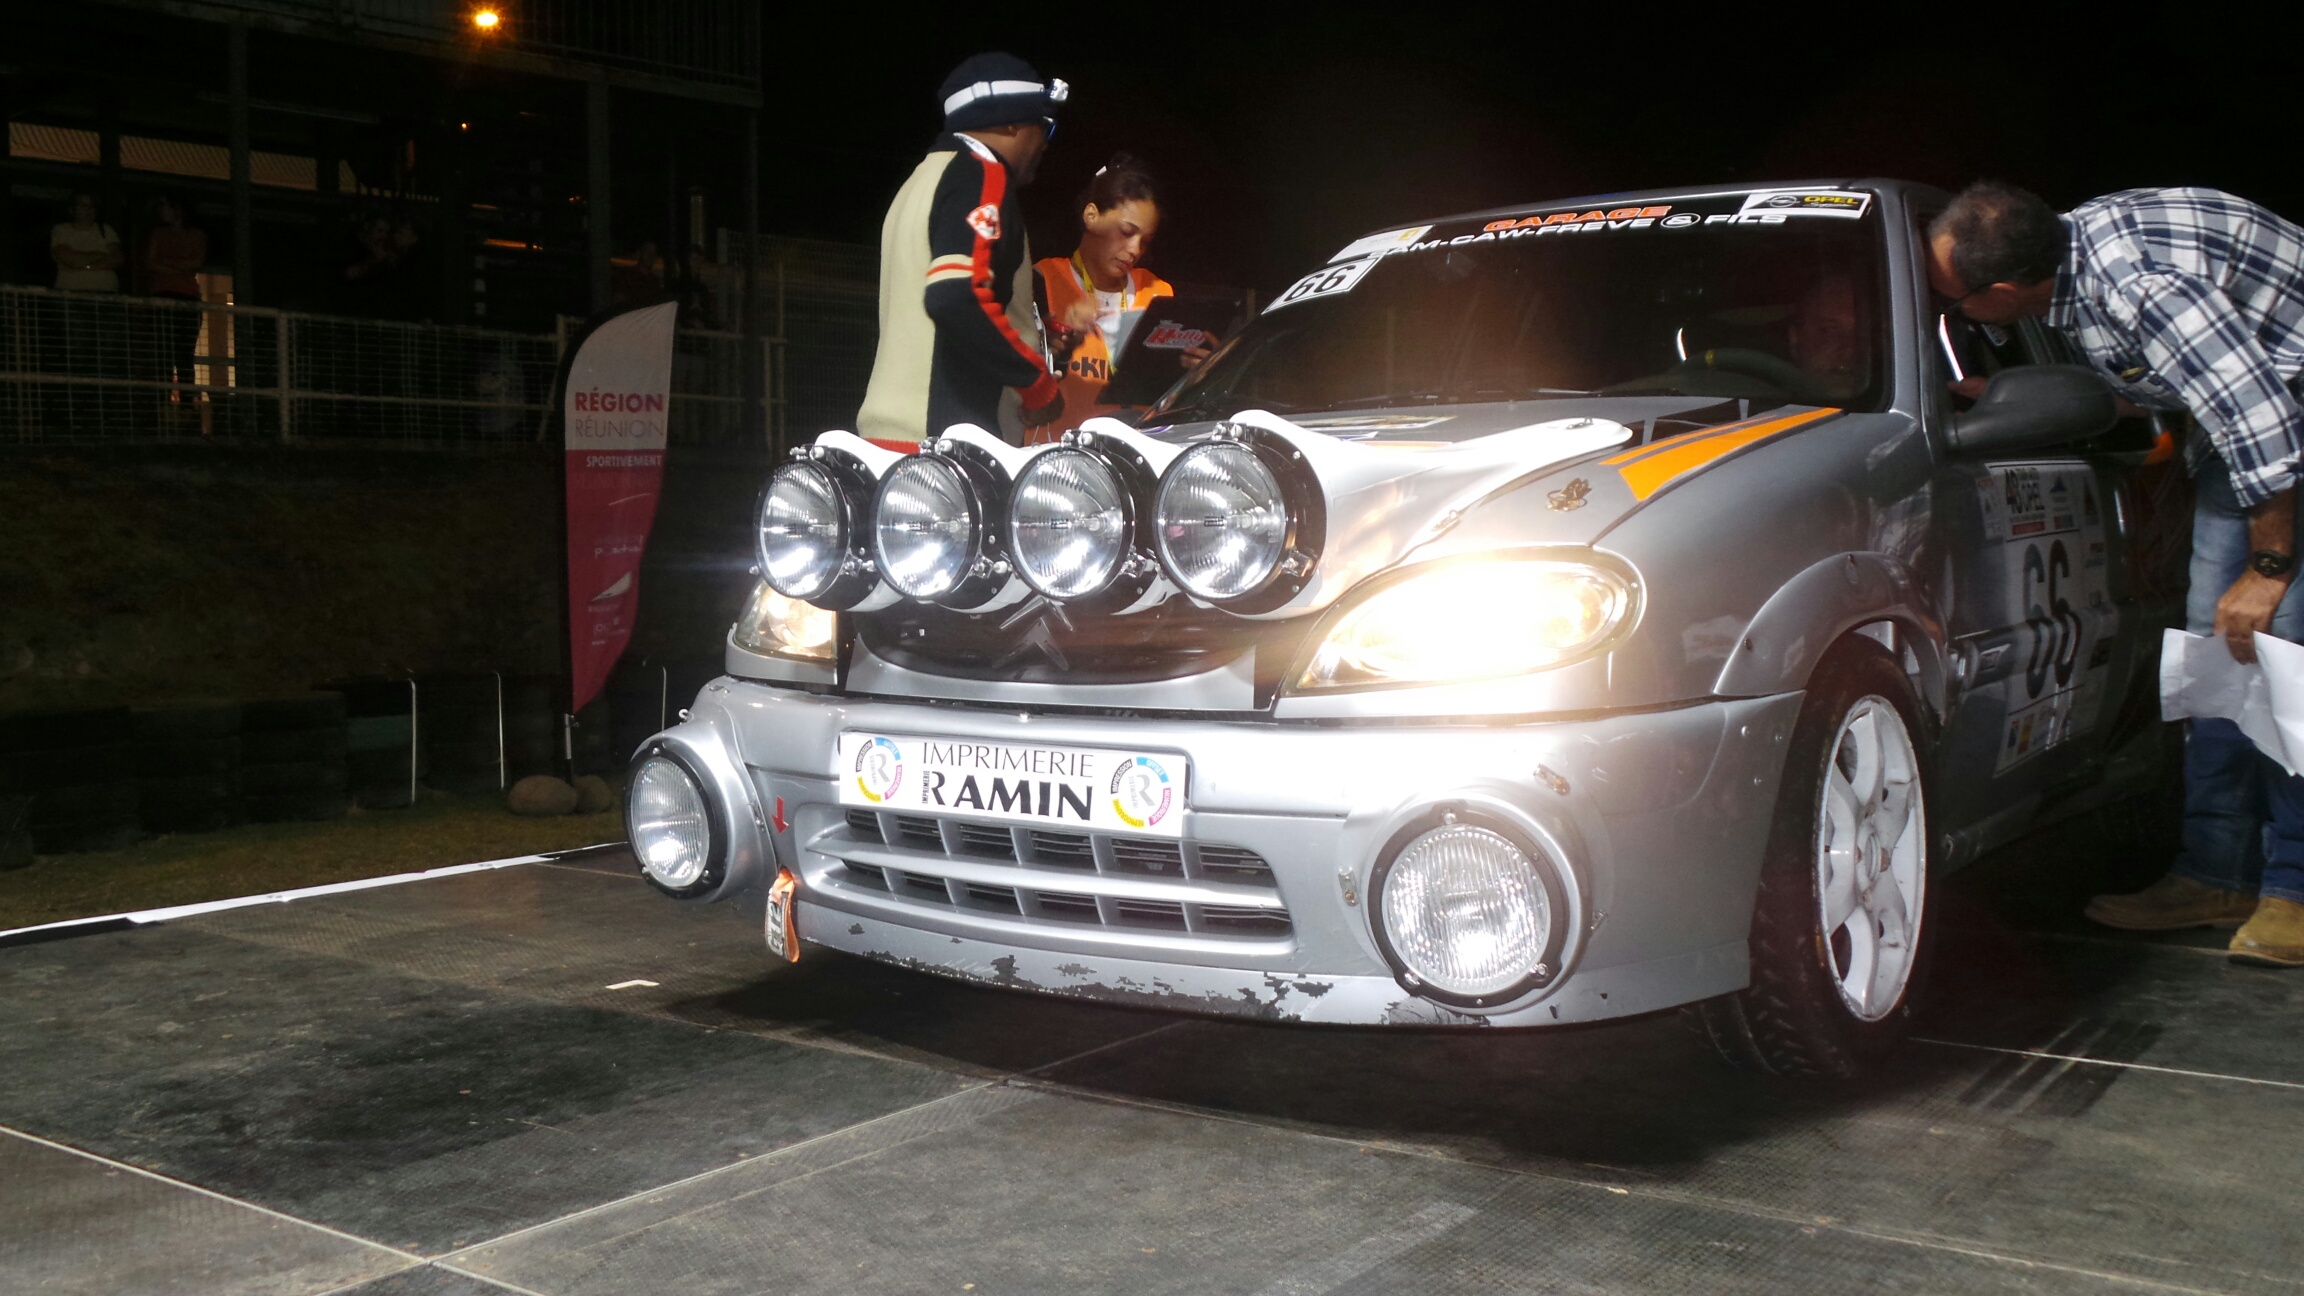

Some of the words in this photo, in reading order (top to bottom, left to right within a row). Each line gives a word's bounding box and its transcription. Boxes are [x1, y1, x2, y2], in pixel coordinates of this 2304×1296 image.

[1804, 195, 1859, 205] OPEL
[1483, 205, 1673, 232] GARAGE
[1703, 213, 1788, 226] FILS
[1283, 264, 1357, 303] 66
[575, 386, 664, 413] RÉGION
[575, 416, 664, 438] RÉUNION
[586, 455, 662, 468] SPORTIVEMENT
[923, 742, 1094, 778] IMPRIMERIE
[922, 770, 930, 804] IMPRIMERIE
[1111, 759, 1132, 792] IMPRESSION
[931, 771, 1093, 821] RAMIN
